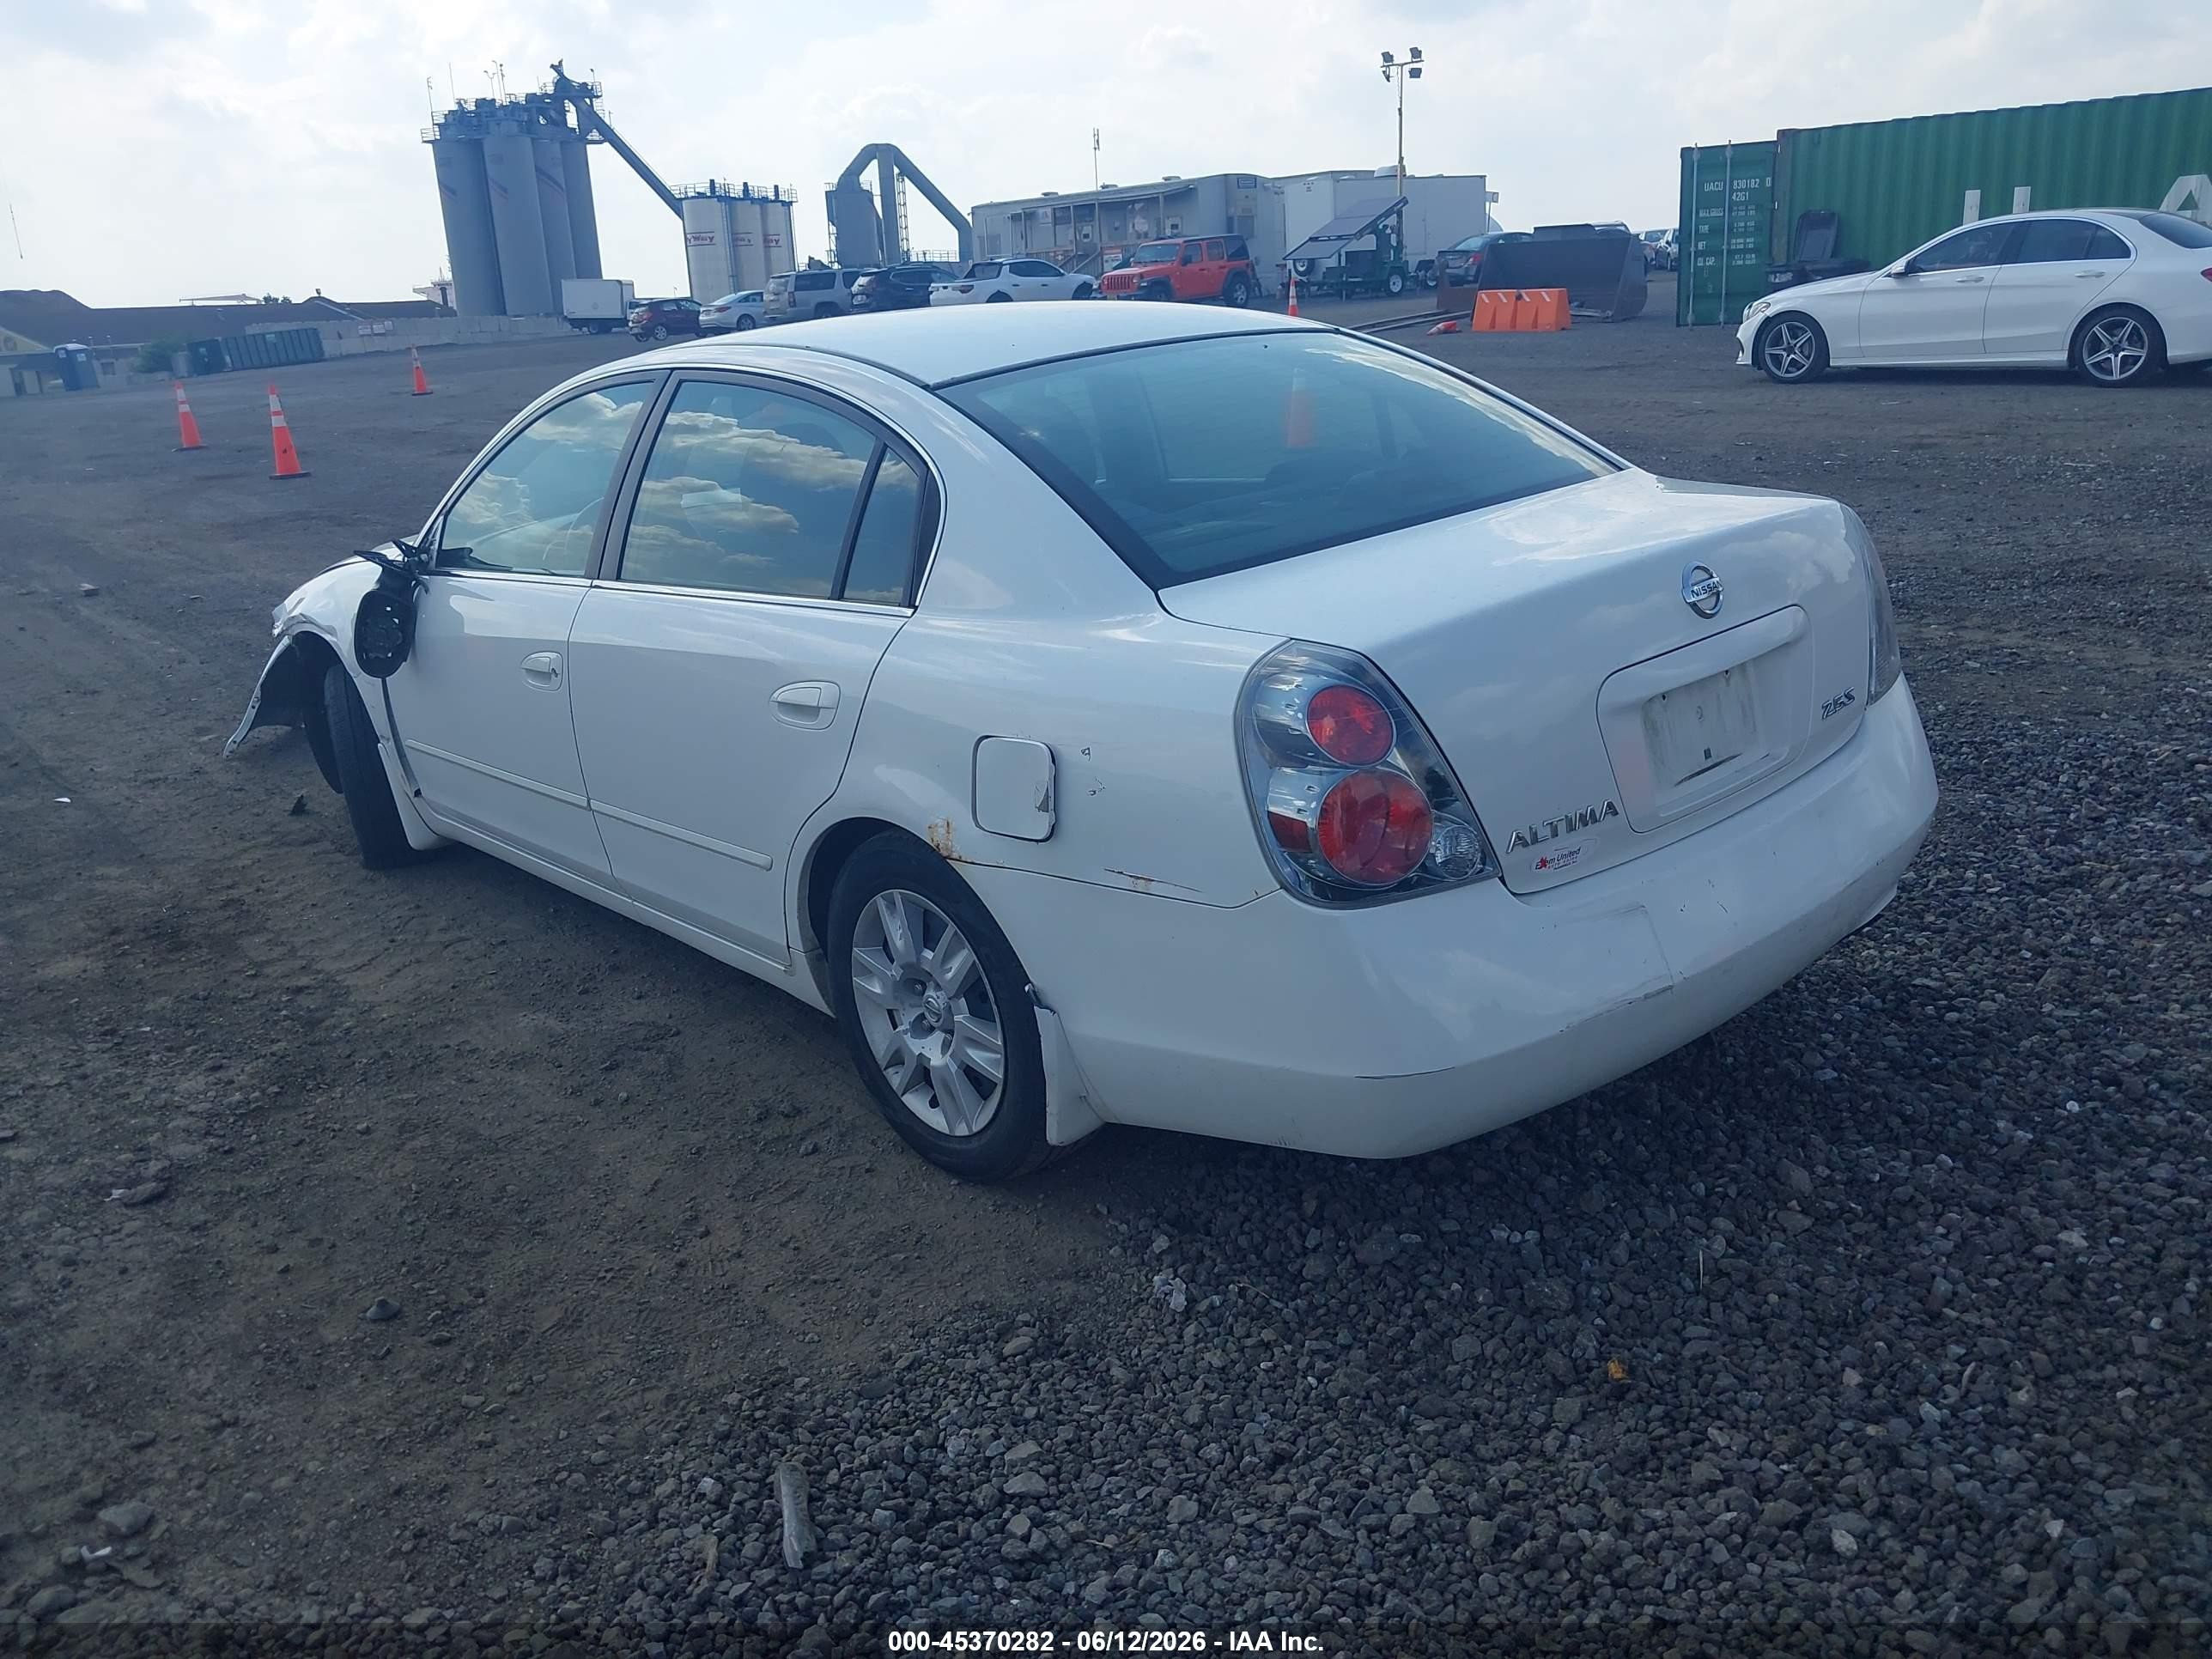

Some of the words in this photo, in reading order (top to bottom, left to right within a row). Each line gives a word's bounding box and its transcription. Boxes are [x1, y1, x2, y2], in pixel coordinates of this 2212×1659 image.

[1704, 181, 1724, 191] UACU
[1733, 178, 1759, 189] 830182
[1732, 191, 1749, 201] 42G1
[1505, 799, 1620, 854] ALTIMA
[1557, 846, 1582, 862] United
